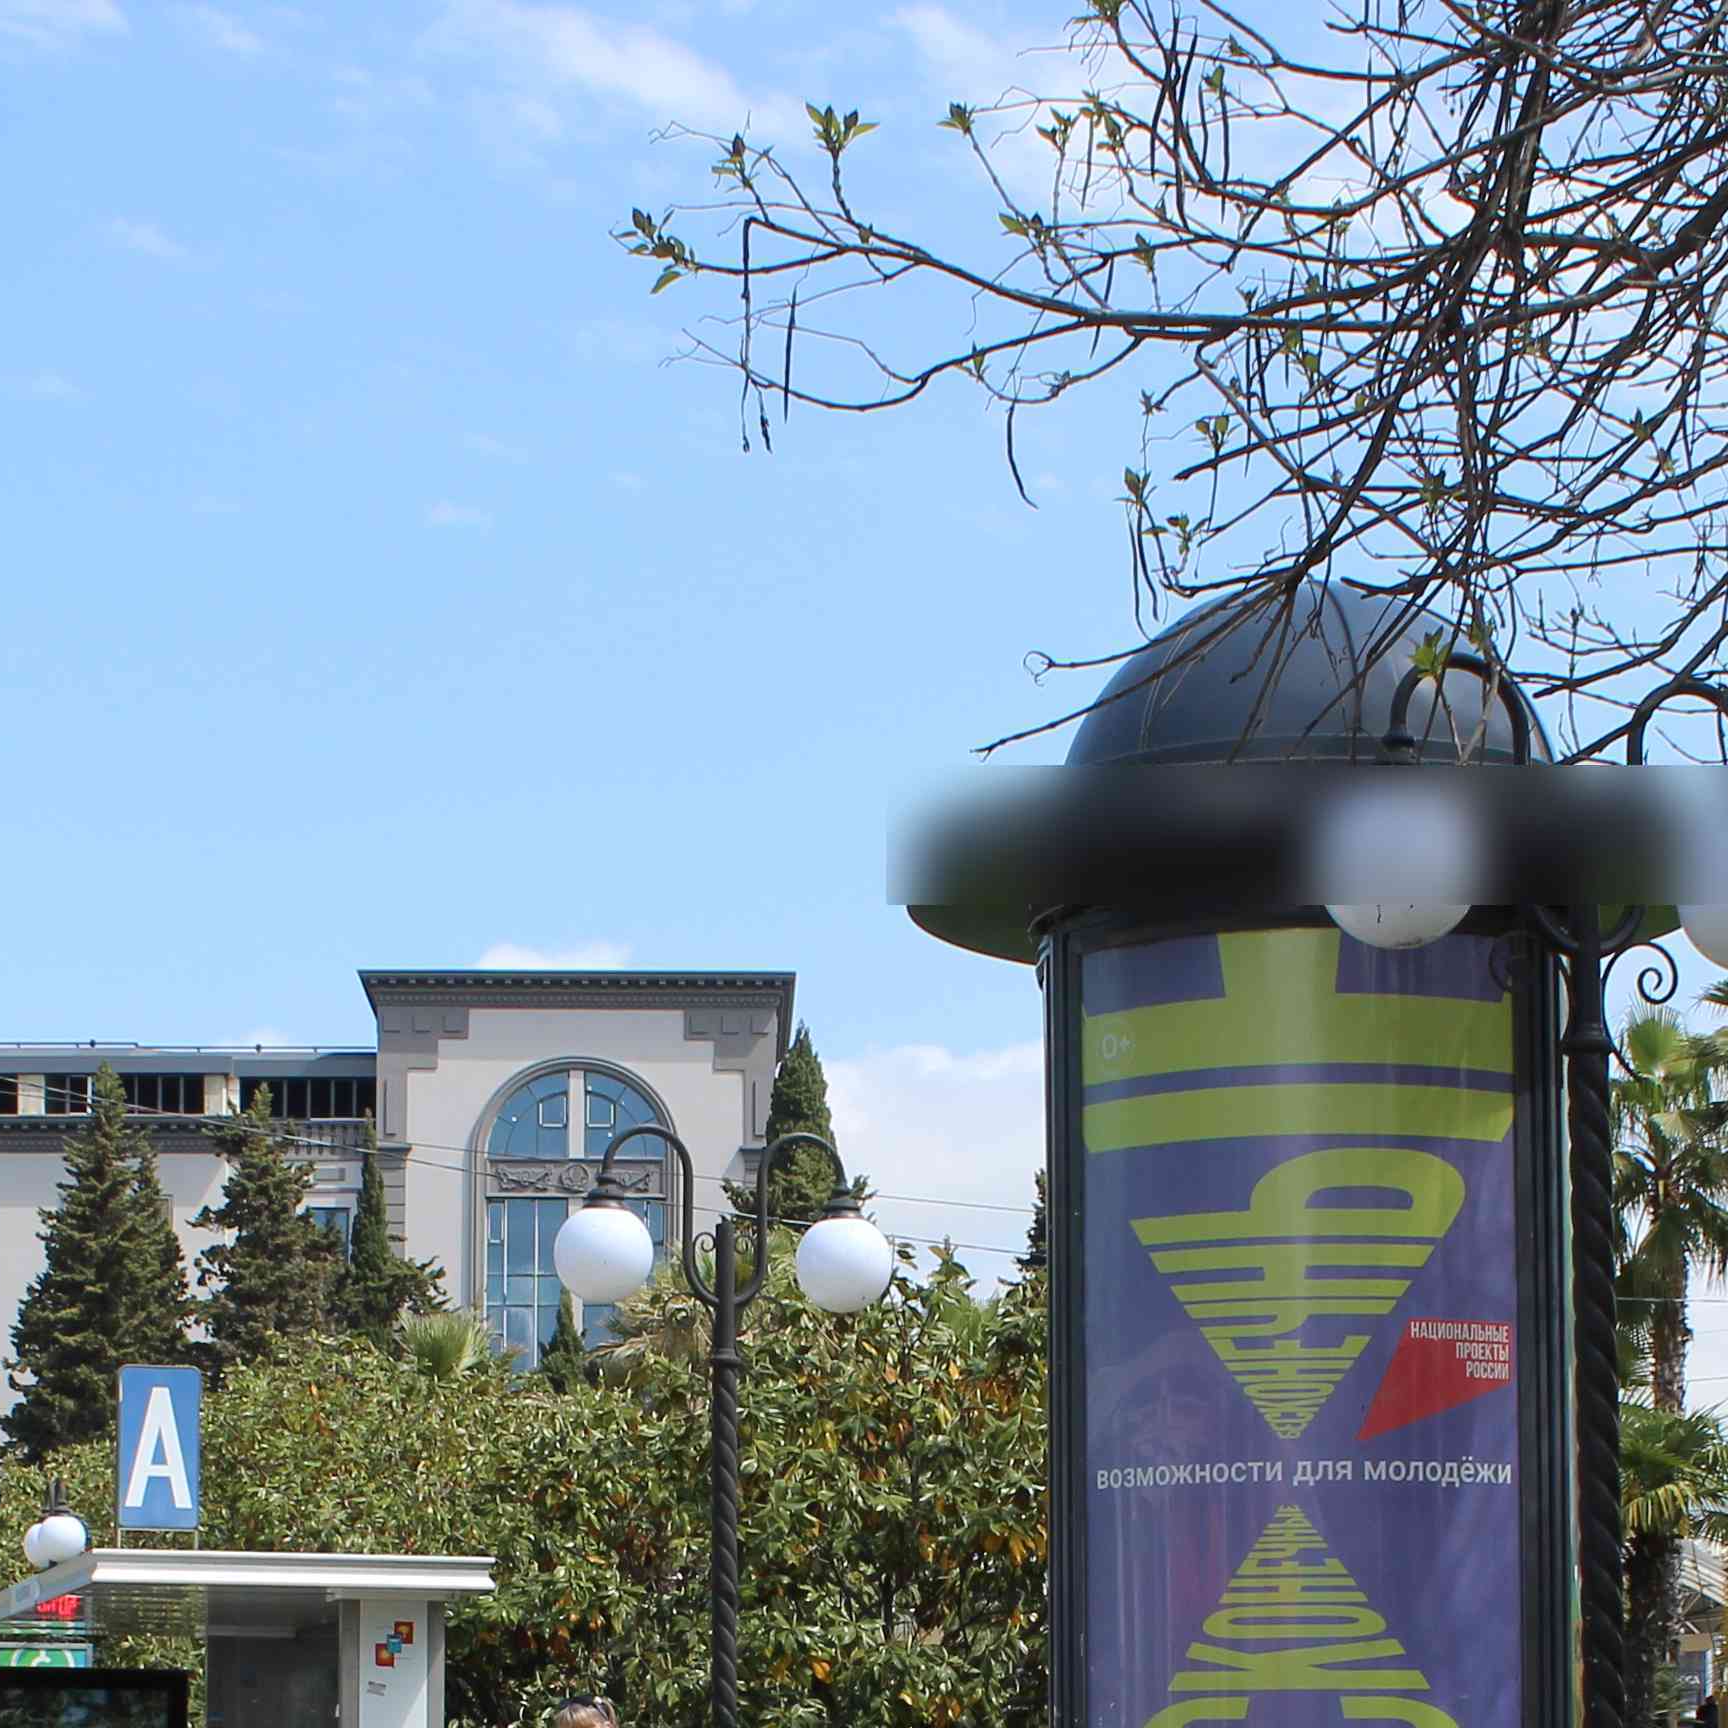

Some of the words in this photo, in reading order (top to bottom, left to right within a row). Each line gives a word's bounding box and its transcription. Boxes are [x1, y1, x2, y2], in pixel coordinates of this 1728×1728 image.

[1410, 1320, 1509, 1343] НАЦИОНАЛЬНЫЕ
[1456, 1341, 1509, 1361] ПРОЕКТЫ
[1465, 1360, 1509, 1380] РОССИИ
[1096, 1460, 1283, 1490] возможности
[1292, 1458, 1353, 1486] для
[1363, 1456, 1513, 1489] молодёжи
